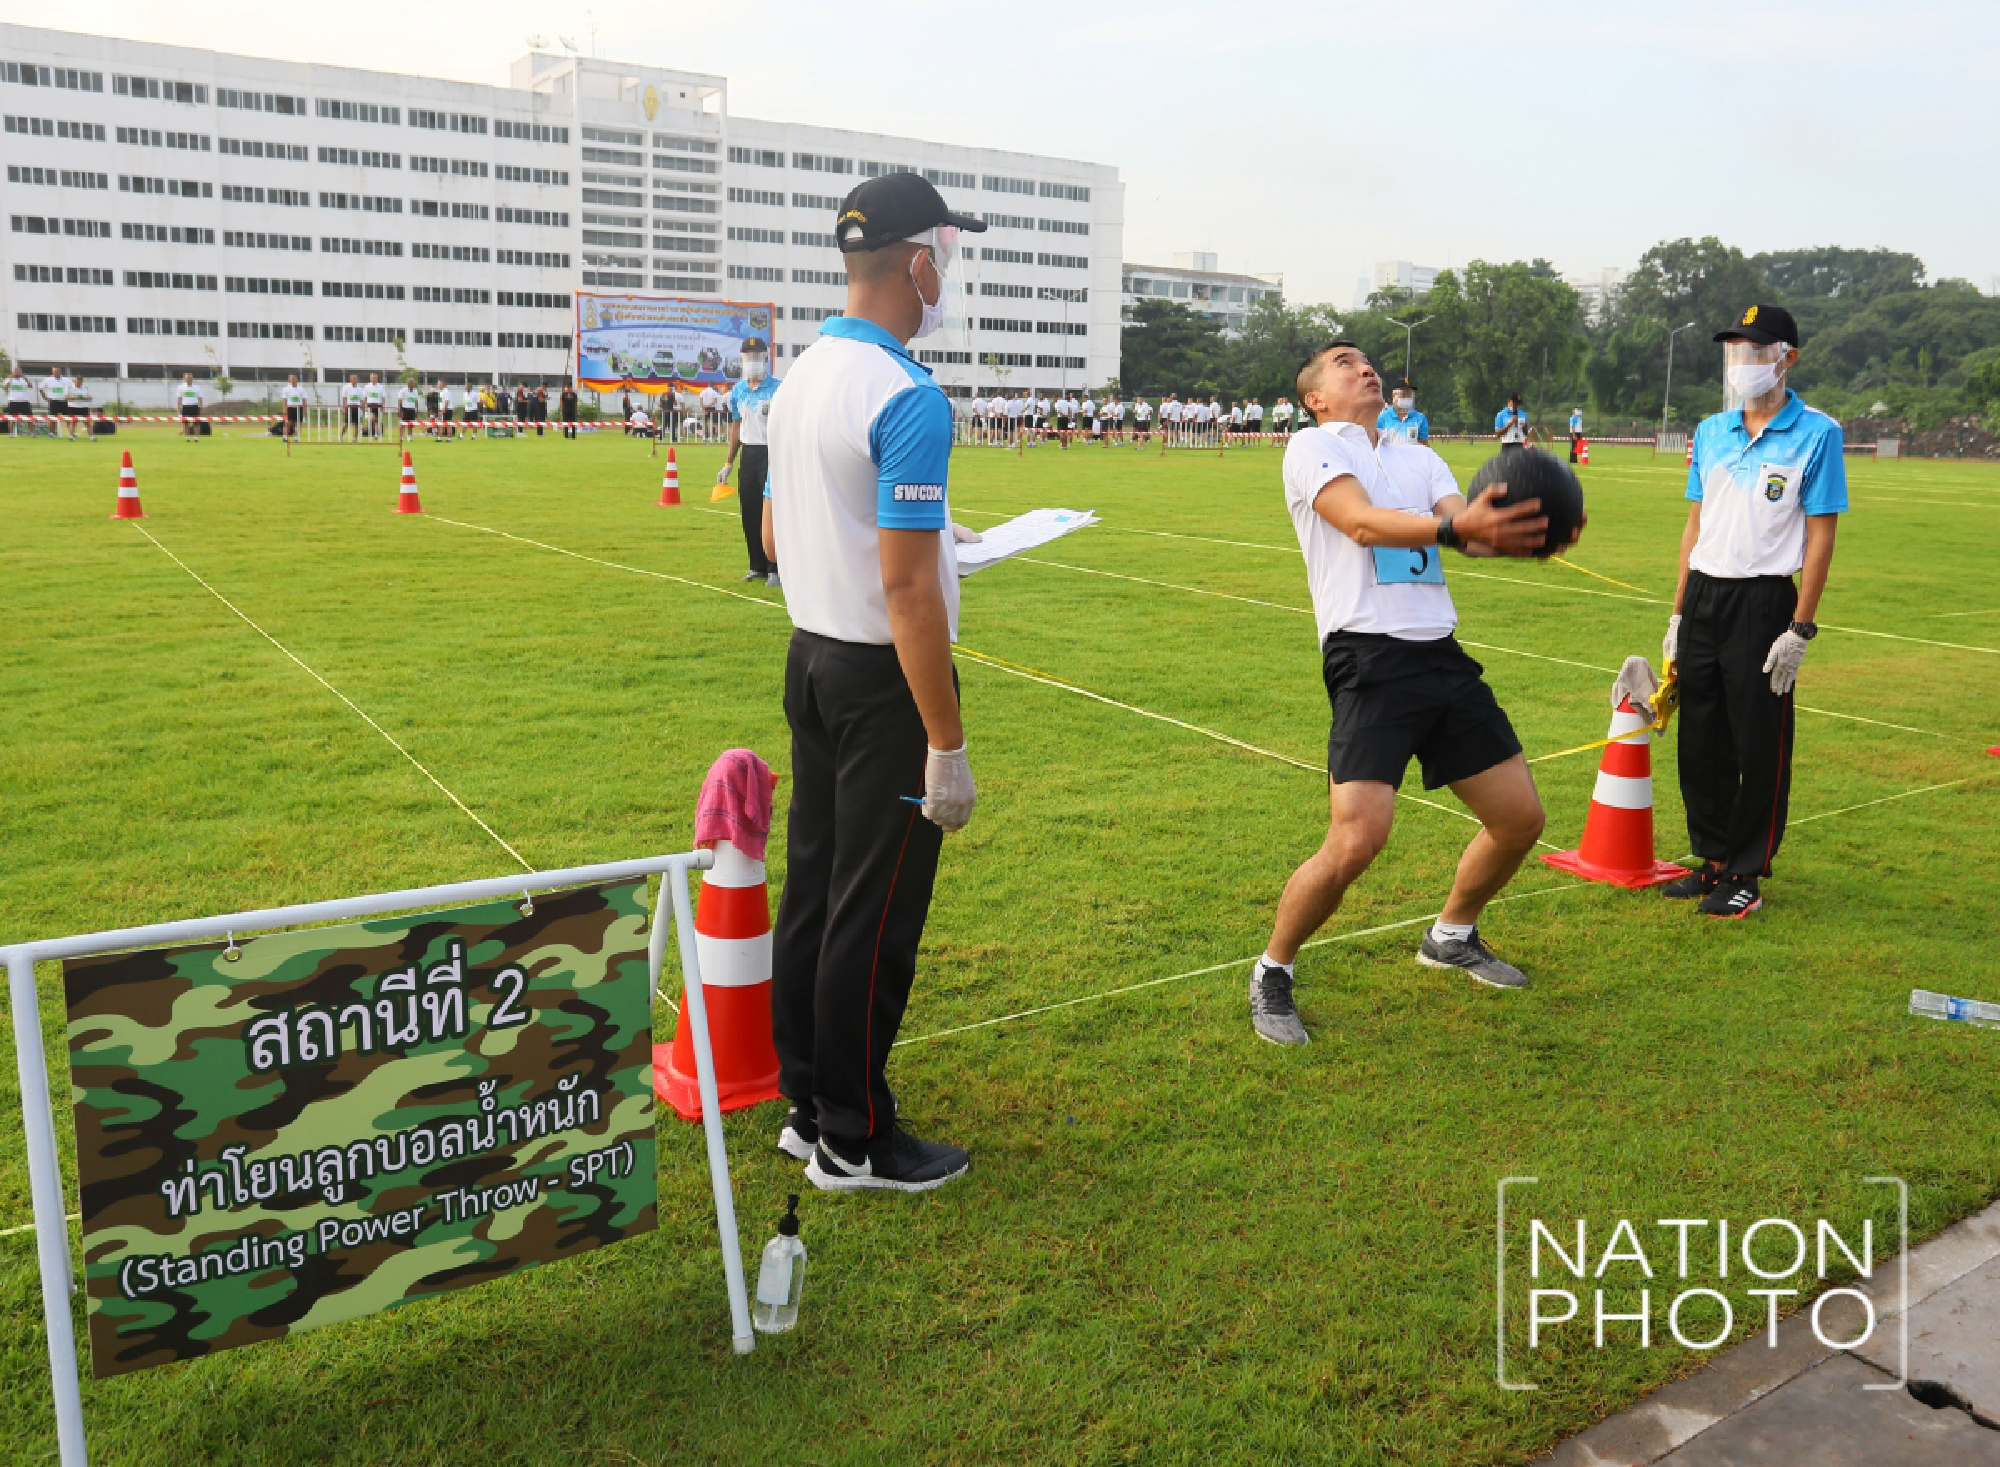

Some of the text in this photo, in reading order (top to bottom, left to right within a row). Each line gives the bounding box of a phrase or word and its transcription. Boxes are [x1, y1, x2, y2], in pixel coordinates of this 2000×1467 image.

[249, 943, 526, 1070] สถานีที่ 2
[161, 1074, 599, 1216] ท่าโยนลูกบอลน้ำหนัก
[121, 1234, 304, 1298] (Standing
[319, 1206, 424, 1253] Power
[436, 1178, 538, 1222] Throw
[571, 1141, 634, 1189] SPT)
